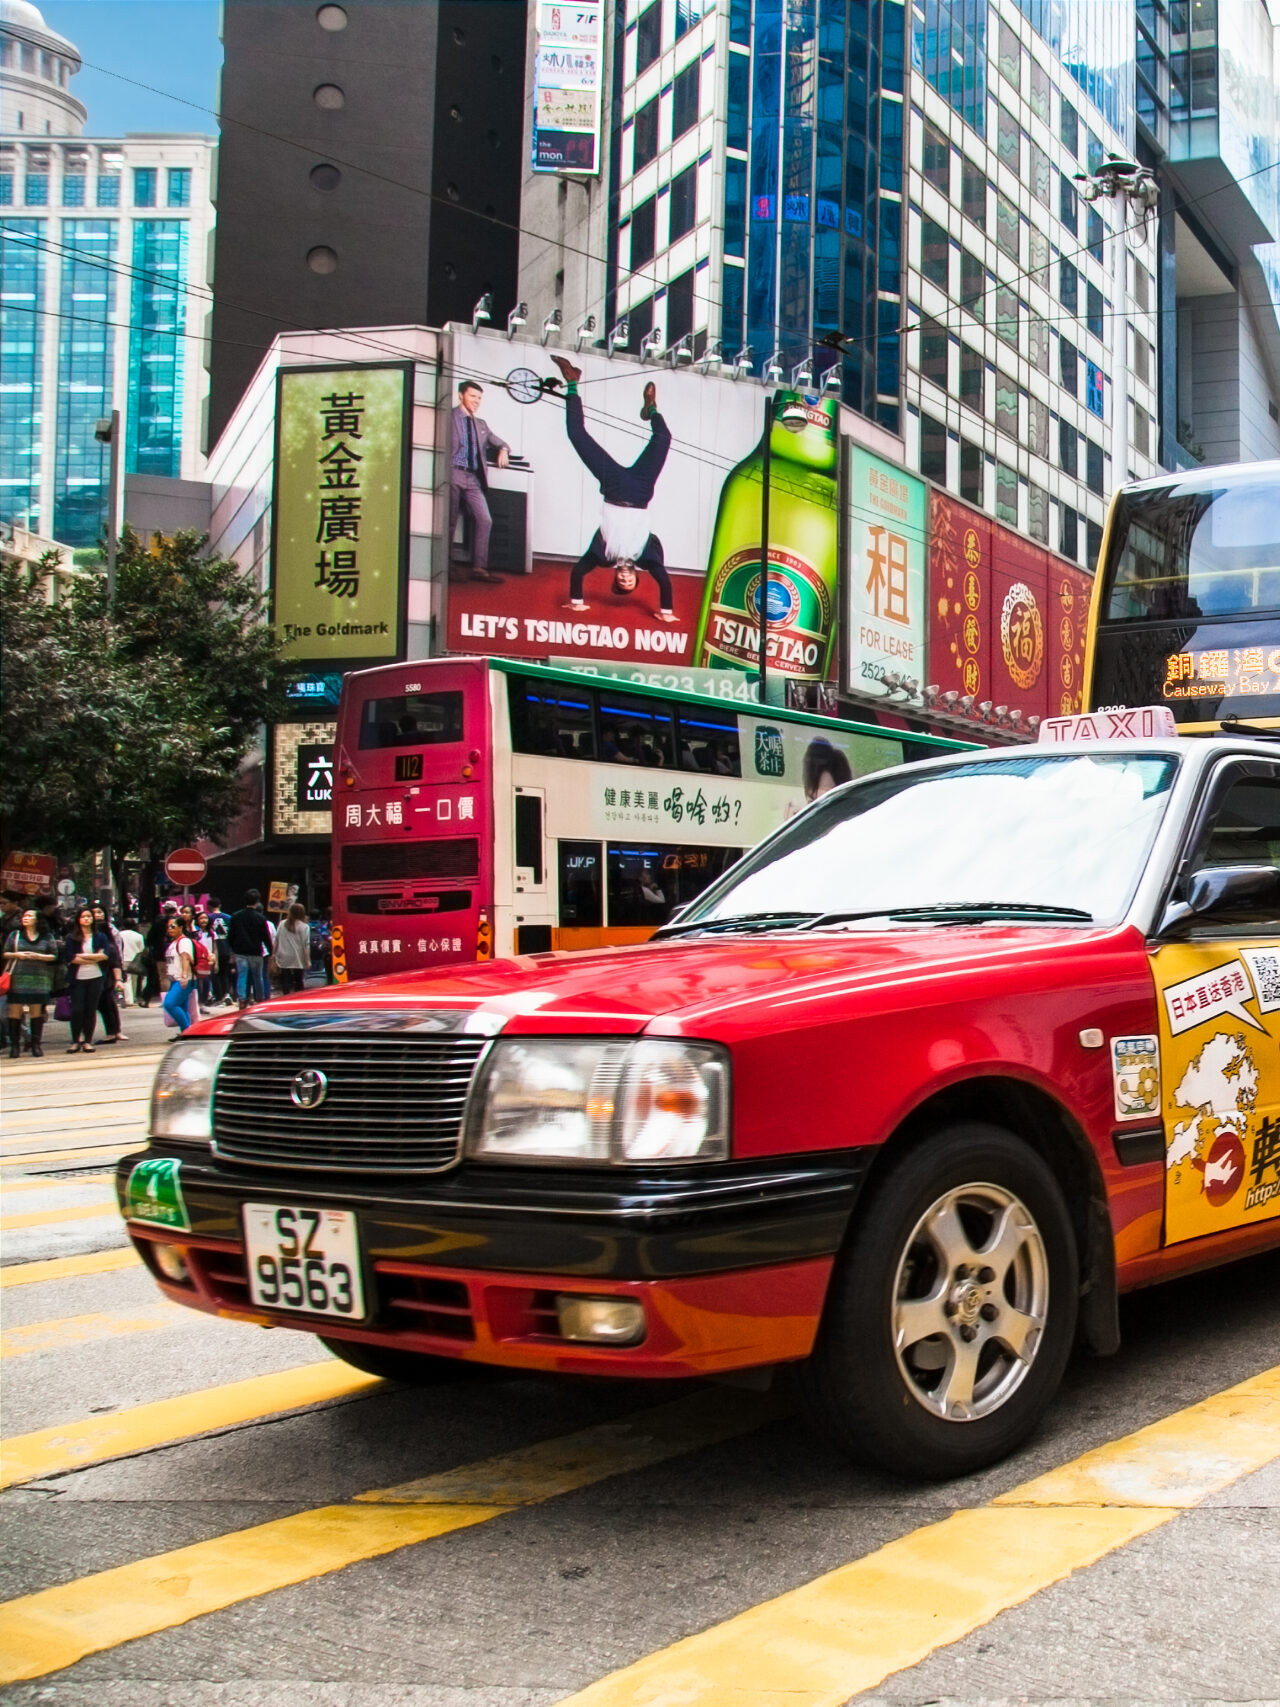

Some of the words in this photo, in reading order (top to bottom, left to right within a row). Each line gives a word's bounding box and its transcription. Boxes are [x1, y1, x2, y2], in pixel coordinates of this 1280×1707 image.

[576, 13, 598, 24] 7/F
[314, 392, 365, 599] 黃金廣場
[866, 525, 910, 625] 租
[963, 532, 979, 692] 恭喜發財
[283, 623, 311, 638] The
[315, 621, 389, 637] Goldmark
[461, 613, 519, 640] LET'S
[524, 618, 629, 649] TSINGTAO
[634, 628, 689, 654] NOW
[712, 614, 819, 667] TSINGTAO
[860, 626, 881, 650] FOR
[883, 634, 914, 661] LEASE
[1011, 607, 1033, 664] 福
[1165, 647, 1265, 681] 銅鑼灣
[404, 683, 422, 693] 5580
[1162, 680, 1237, 698] Causeway
[1239, 675, 1271, 696] Bay
[1046, 709, 1154, 742] TAXI
[308, 756, 333, 788] 六
[402, 756, 420, 779] 112
[306, 788, 333, 801] LUK
[604, 786, 660, 810] 健康美麗
[345, 801, 403, 828] 周大福
[414, 796, 475, 821] 一口價
[1171, 971, 1245, 1020] 日本直送香港
[275, 1208, 326, 1261] SZ
[257, 1254, 354, 1314] 9563
